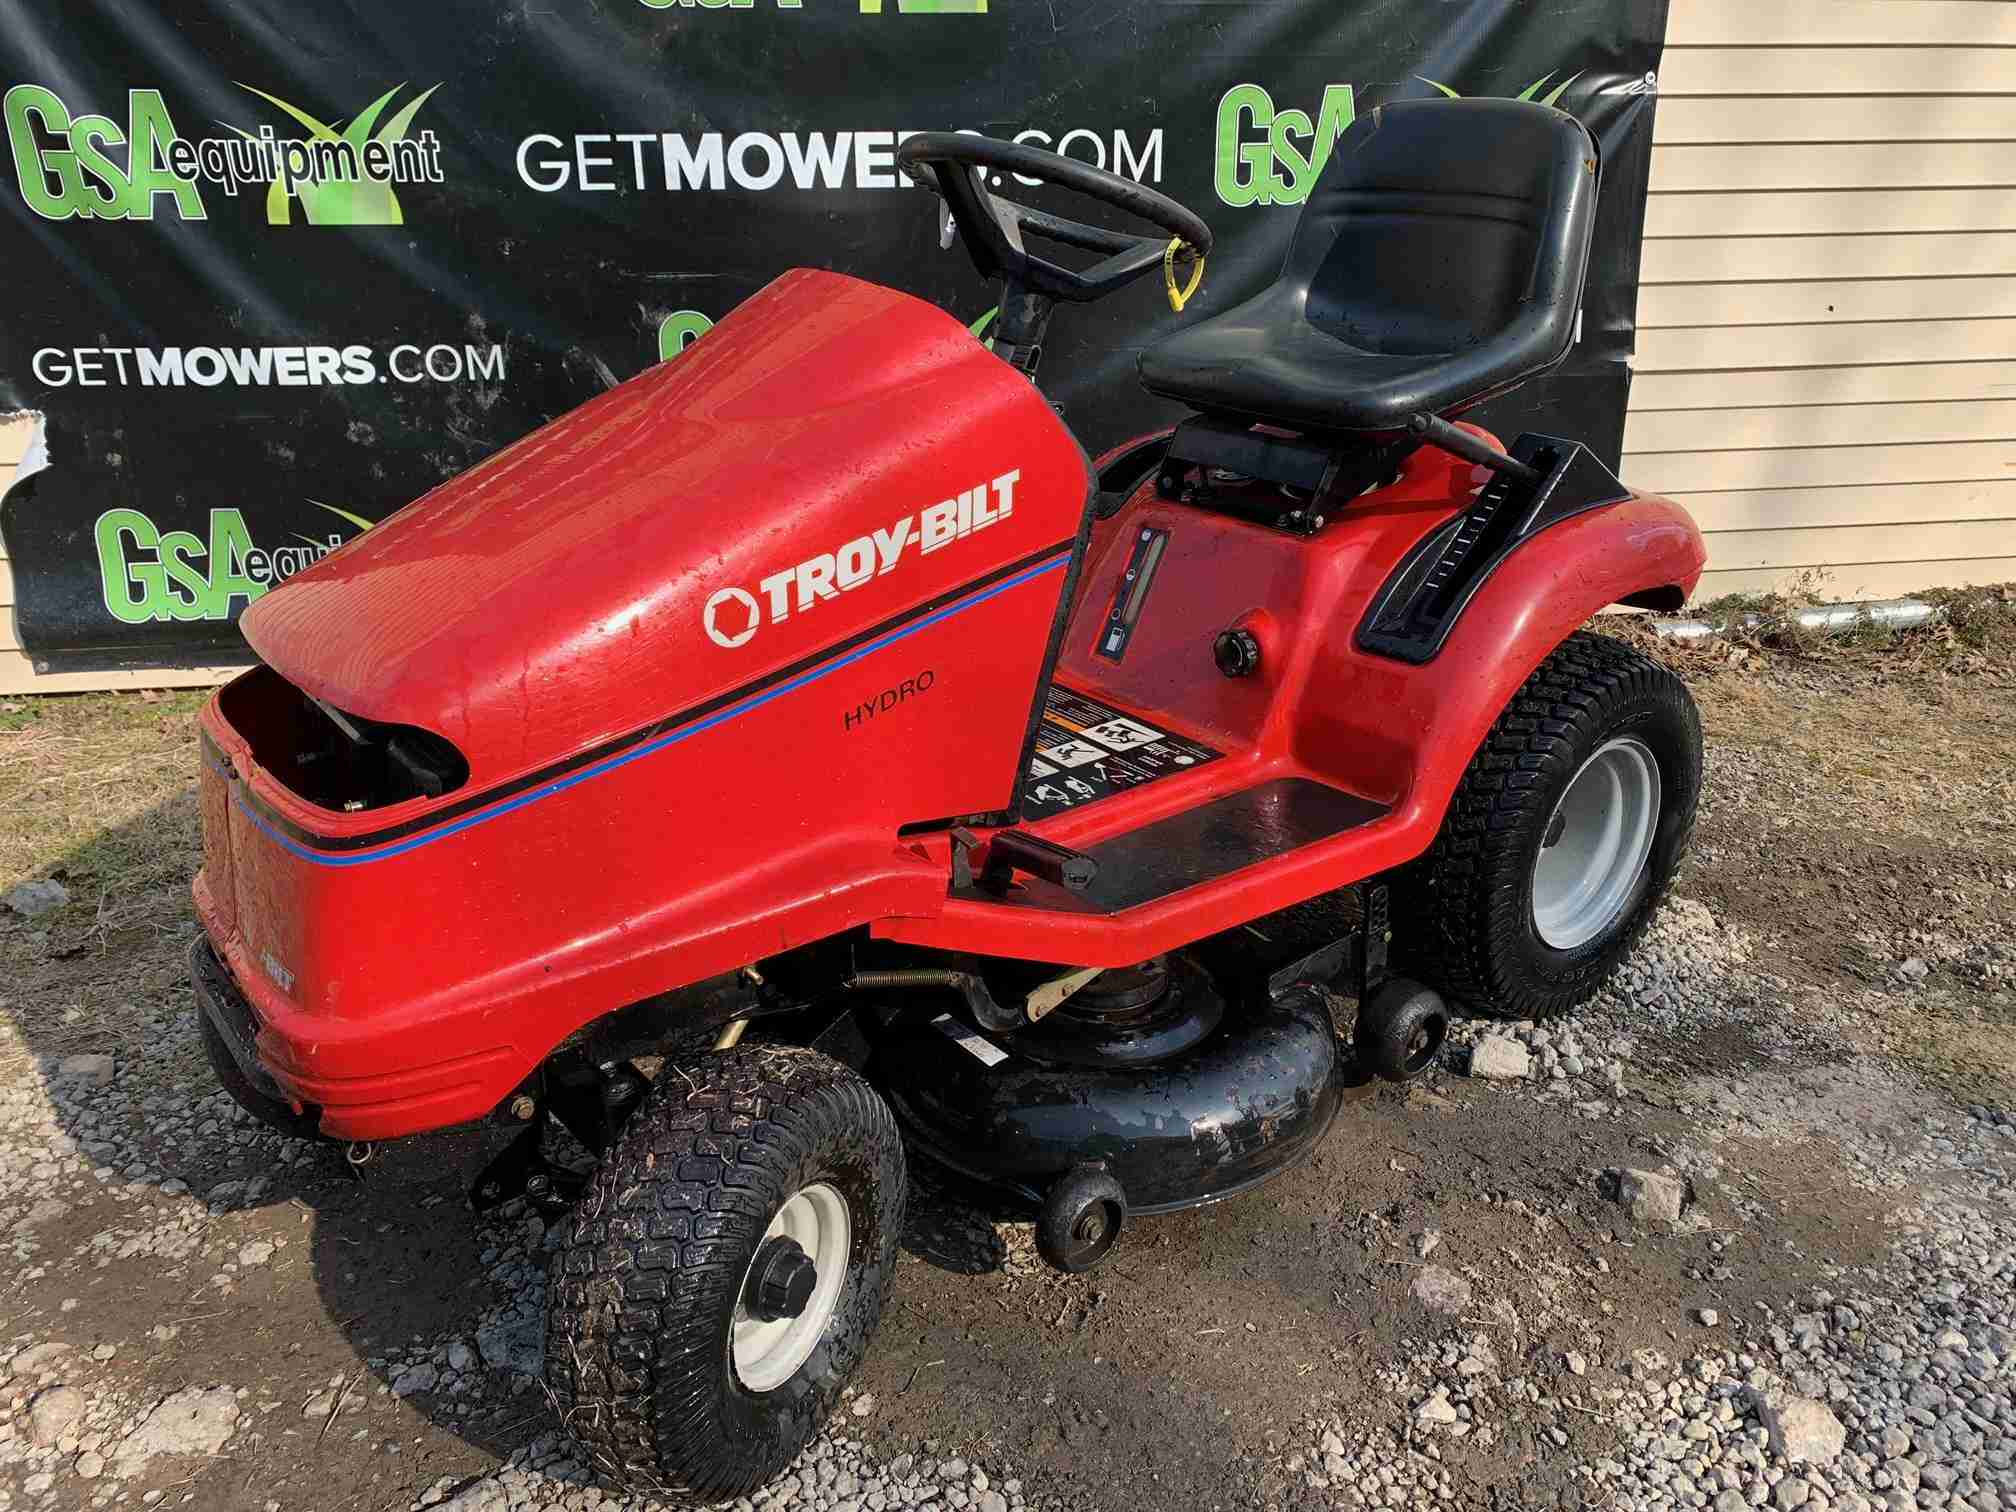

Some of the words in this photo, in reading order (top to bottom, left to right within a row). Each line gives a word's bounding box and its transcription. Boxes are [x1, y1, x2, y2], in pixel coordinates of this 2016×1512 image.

[31, 343, 506, 387] GETMOWERS.COM
[760, 468, 1020, 625] TROY-BILT
[842, 670, 935, 731] HYDRO
